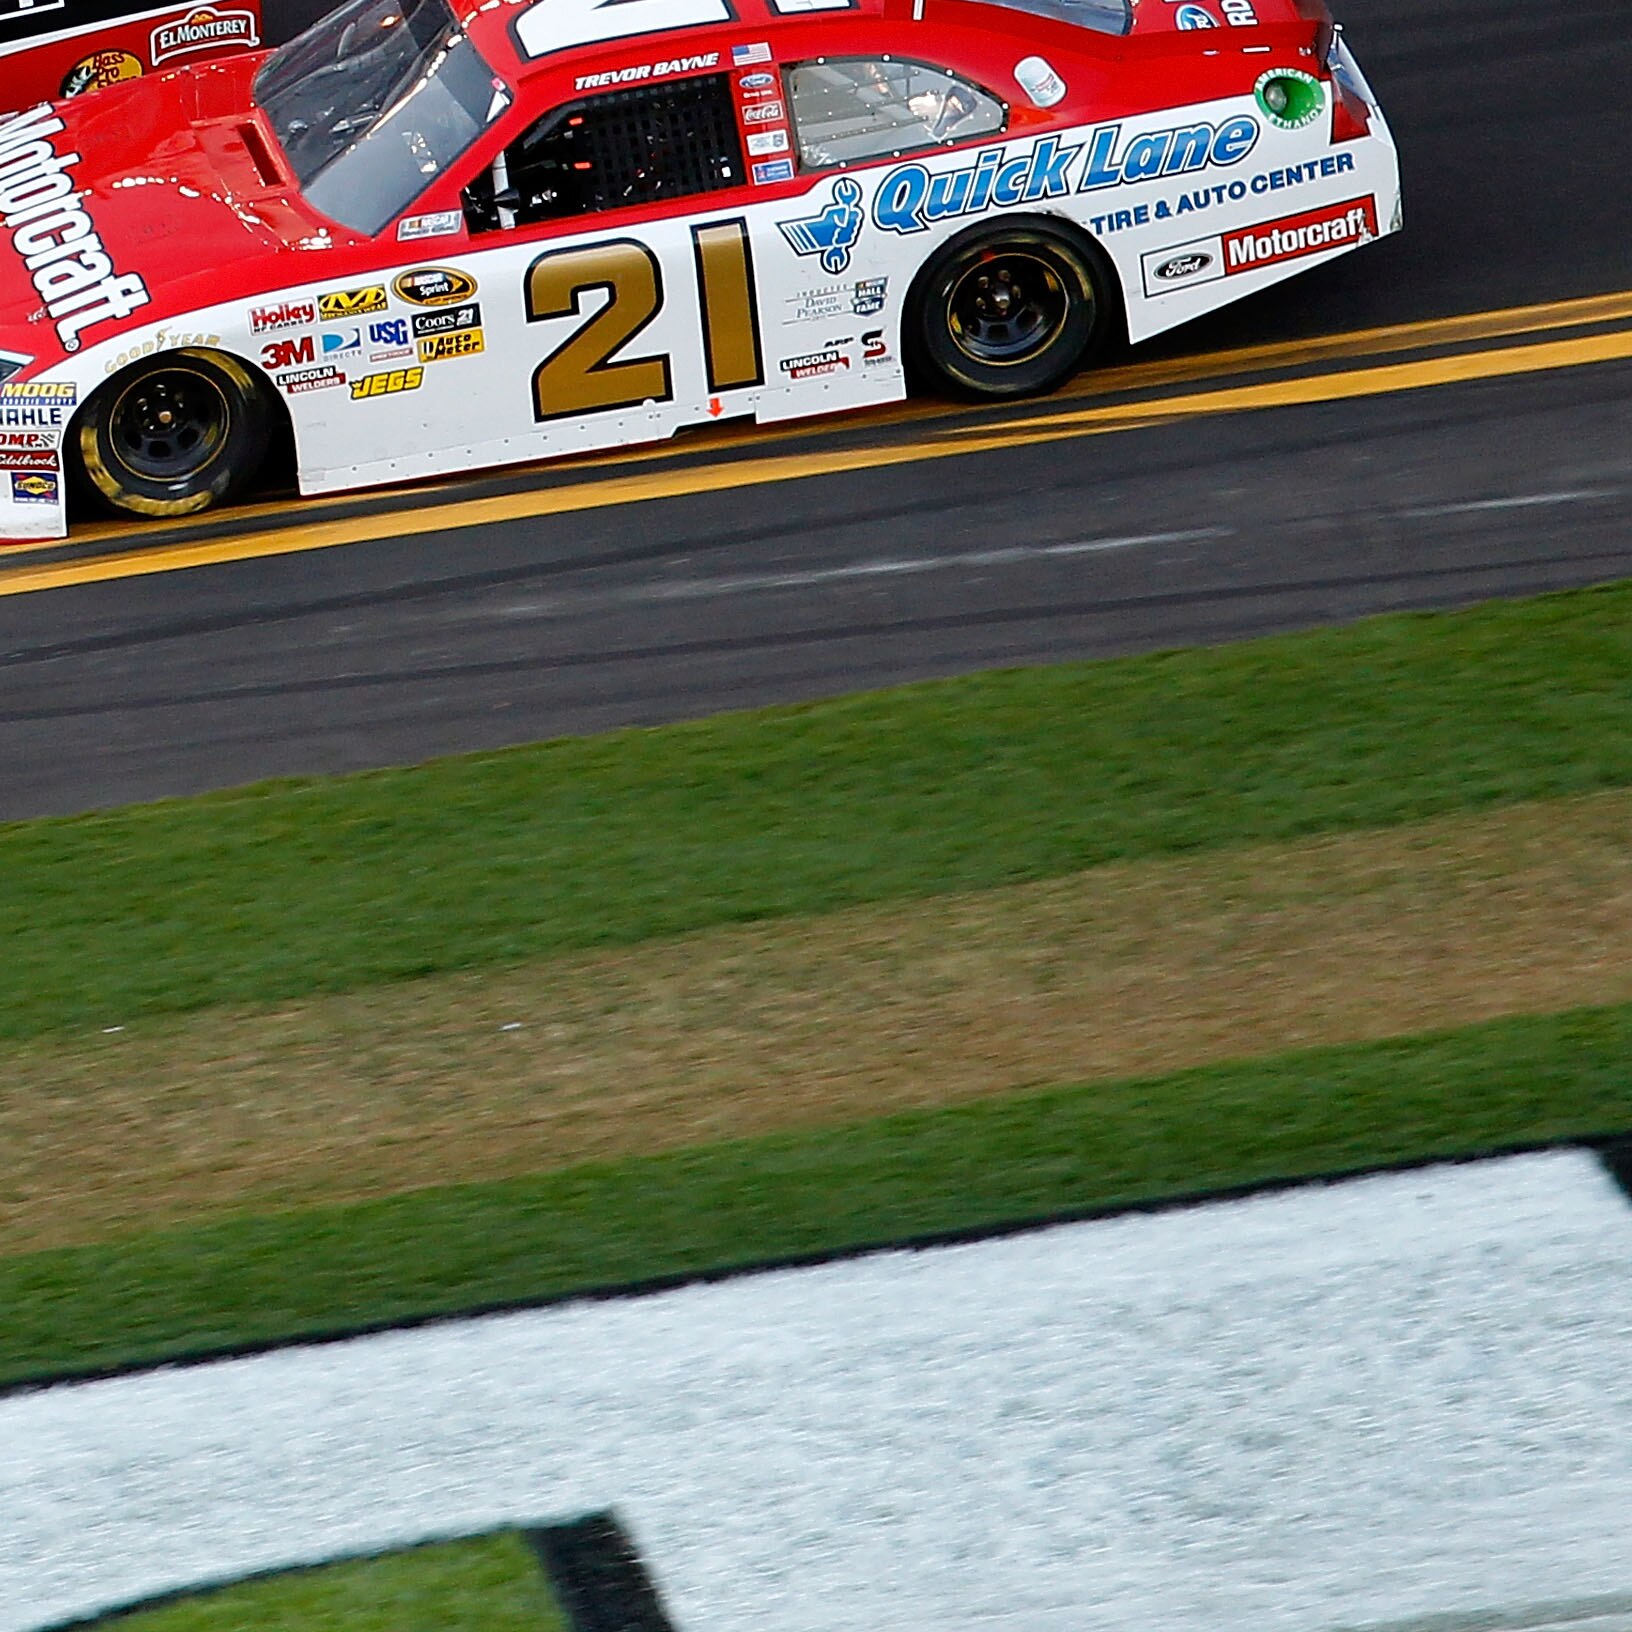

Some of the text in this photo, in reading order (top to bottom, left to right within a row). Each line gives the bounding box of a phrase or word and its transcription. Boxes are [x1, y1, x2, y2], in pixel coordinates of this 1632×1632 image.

[92, 51, 127, 70] Bass
[574, 52, 719, 90] TREVOR BAYNE
[95, 67, 120, 79] Pro
[1254, 68, 1314, 90] AMERICAN
[1268, 103, 1324, 129] ETHANOL
[872, 115, 1258, 235] Quick Lane
[1090, 152, 1355, 235] TIRE & AUTO CENTER
[1164, 207, 1366, 278] Ford Motorcraft
[420, 282, 449, 296] Sprint
[858, 287, 881, 298] HALL
[796, 304, 842, 318] PEARSON
[805, 296, 837, 308] DAVID
[251, 303, 316, 328] Holley
[416, 314, 455, 330] Coors
[456, 308, 474, 326] 21
[524, 216, 765, 423] 21
[369, 319, 409, 345] USG
[437, 334, 471, 346] Auto
[105, 326, 220, 373] GOODYEAR
[261, 335, 315, 370] 3M
[782, 351, 837, 370] LINCOLN
[278, 367, 334, 385] LINCOLN
[291, 378, 341, 393] WELDERS
[353, 367, 423, 399] JEGS
[0, 383, 75, 398] MOOG
